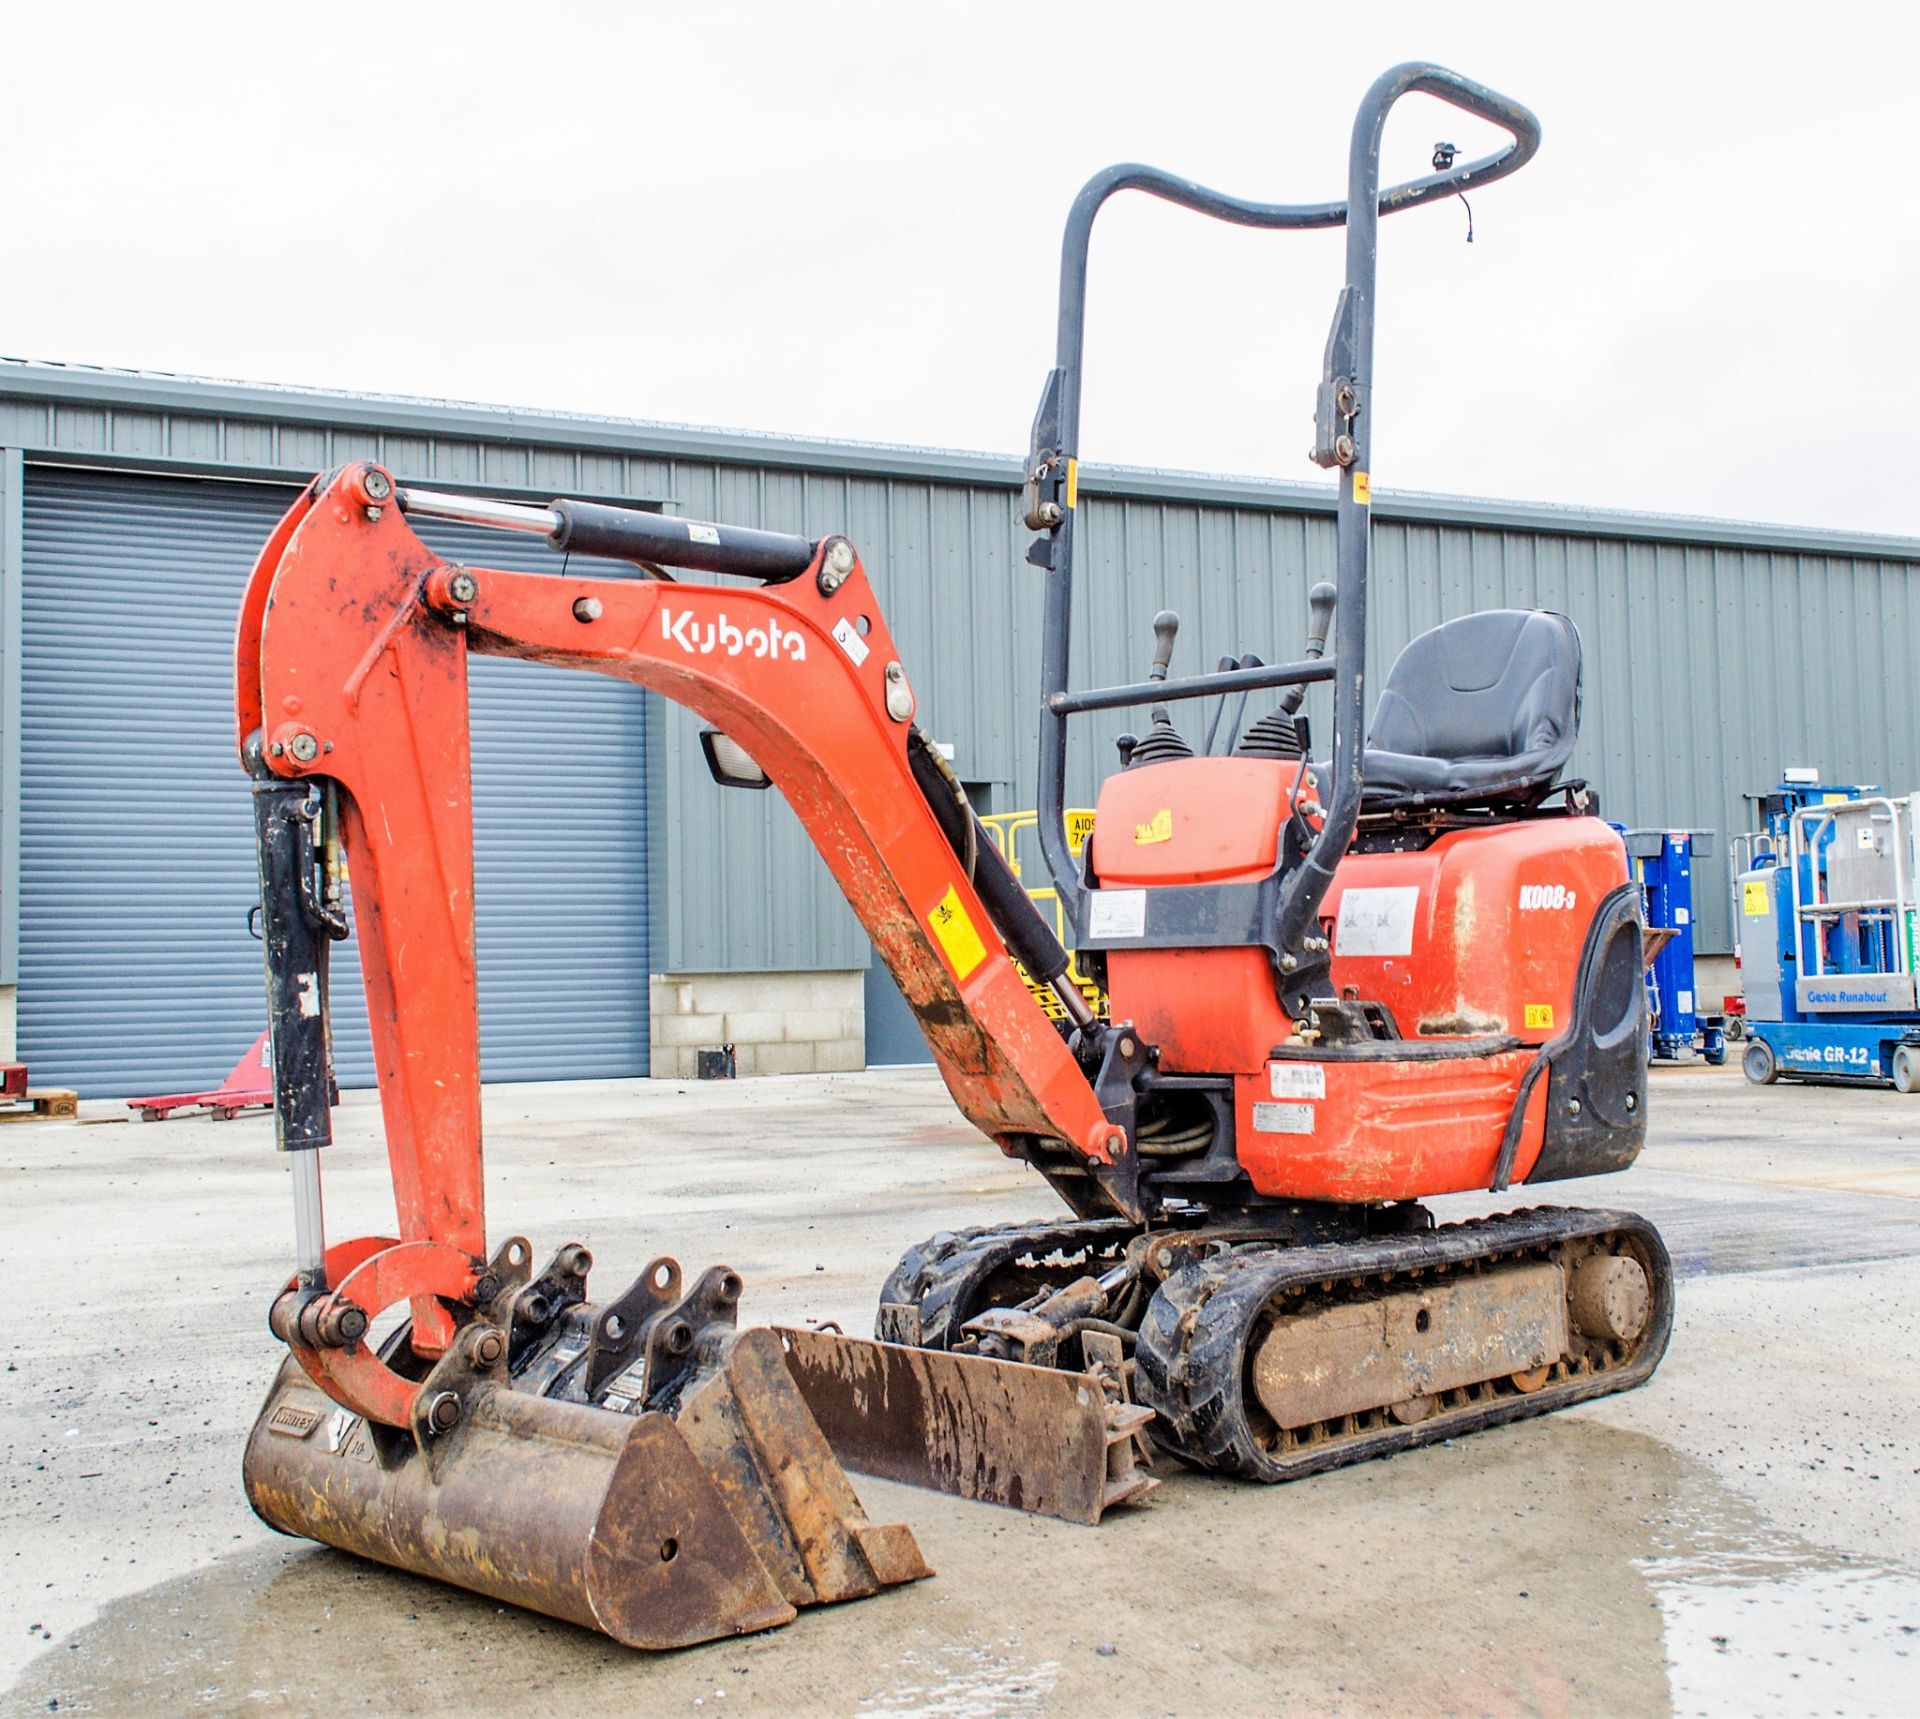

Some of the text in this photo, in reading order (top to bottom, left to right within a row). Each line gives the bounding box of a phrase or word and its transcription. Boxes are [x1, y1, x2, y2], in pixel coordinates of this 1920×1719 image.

[661, 608, 806, 661] Kubota
[1519, 885, 1577, 910] K008-3
[1807, 991, 1887, 1003] Genie Runabout
[1823, 1046, 1869, 1064] GR-12
